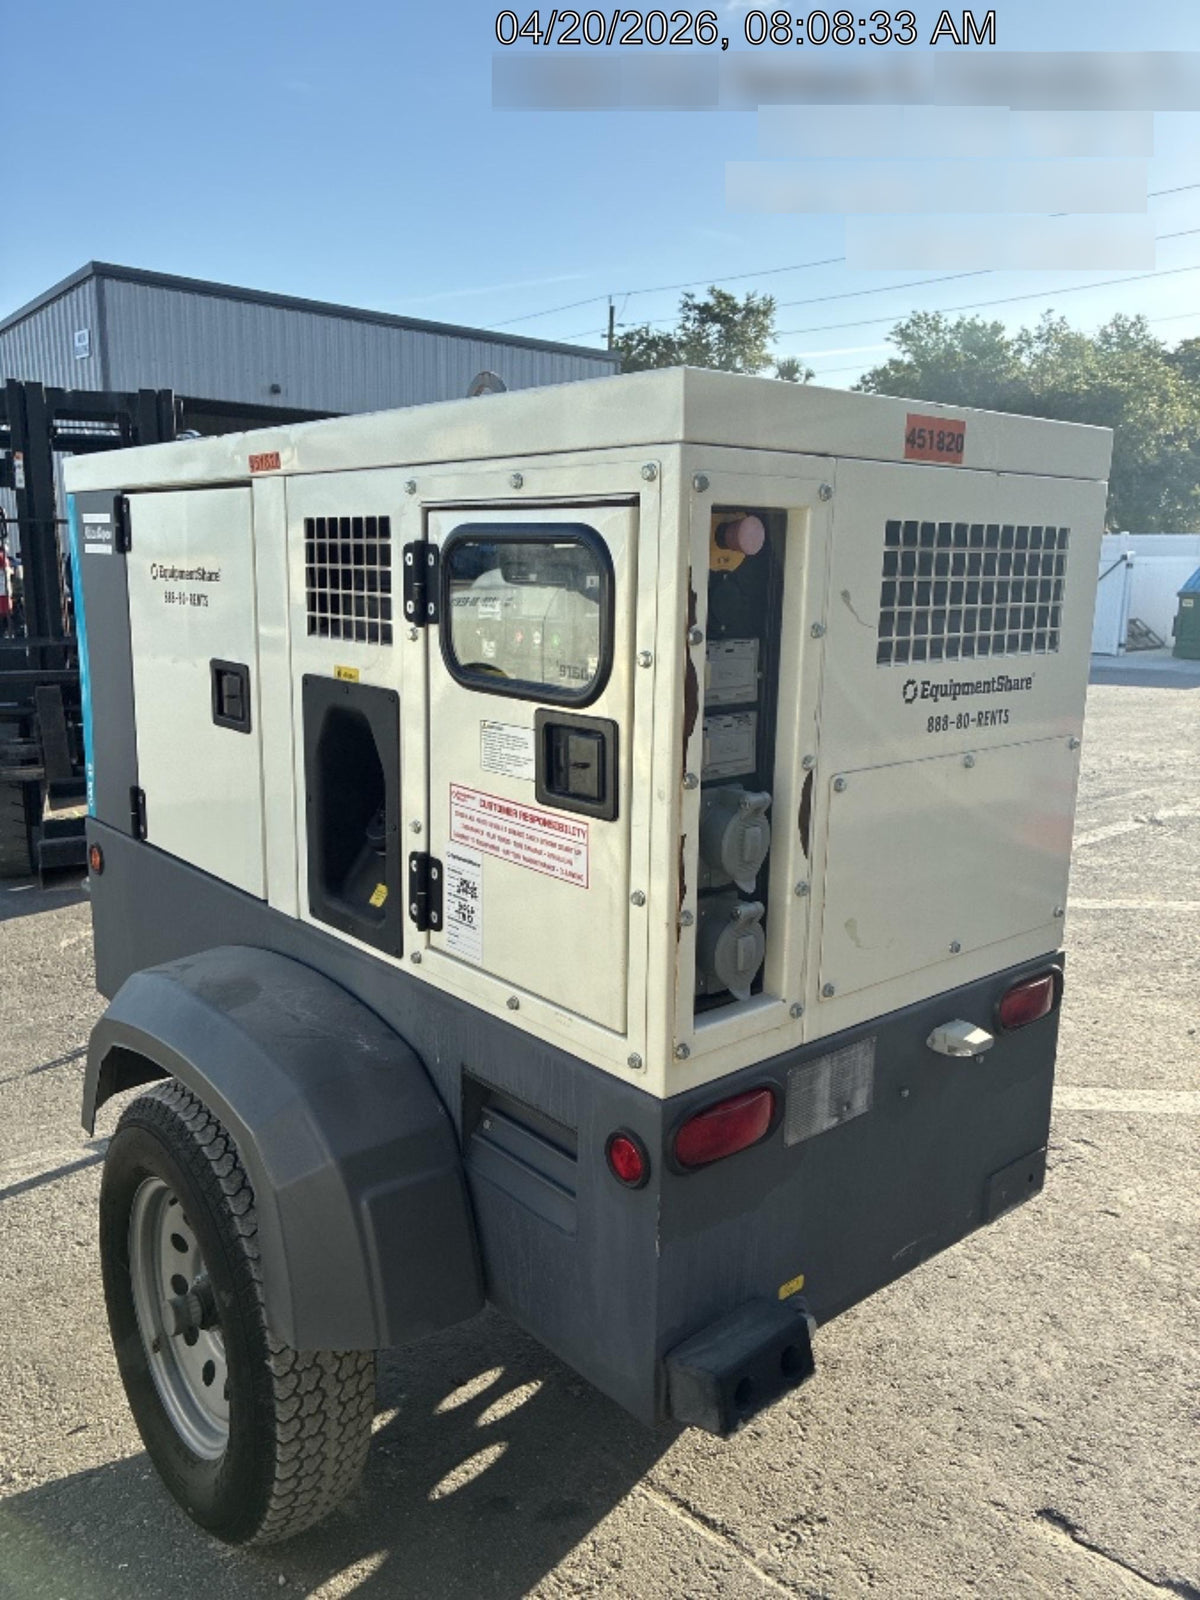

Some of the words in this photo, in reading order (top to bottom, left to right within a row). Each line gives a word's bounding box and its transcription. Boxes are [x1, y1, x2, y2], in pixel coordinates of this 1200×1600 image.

[906, 427, 964, 455] 451820
[920, 676, 1033, 703] EquipmentShare
[927, 708, 1010, 733] 888-80-RENTS
[479, 798, 518, 819] CUSTOMER
[519, 810, 587, 840] RESPONSIBILITY
